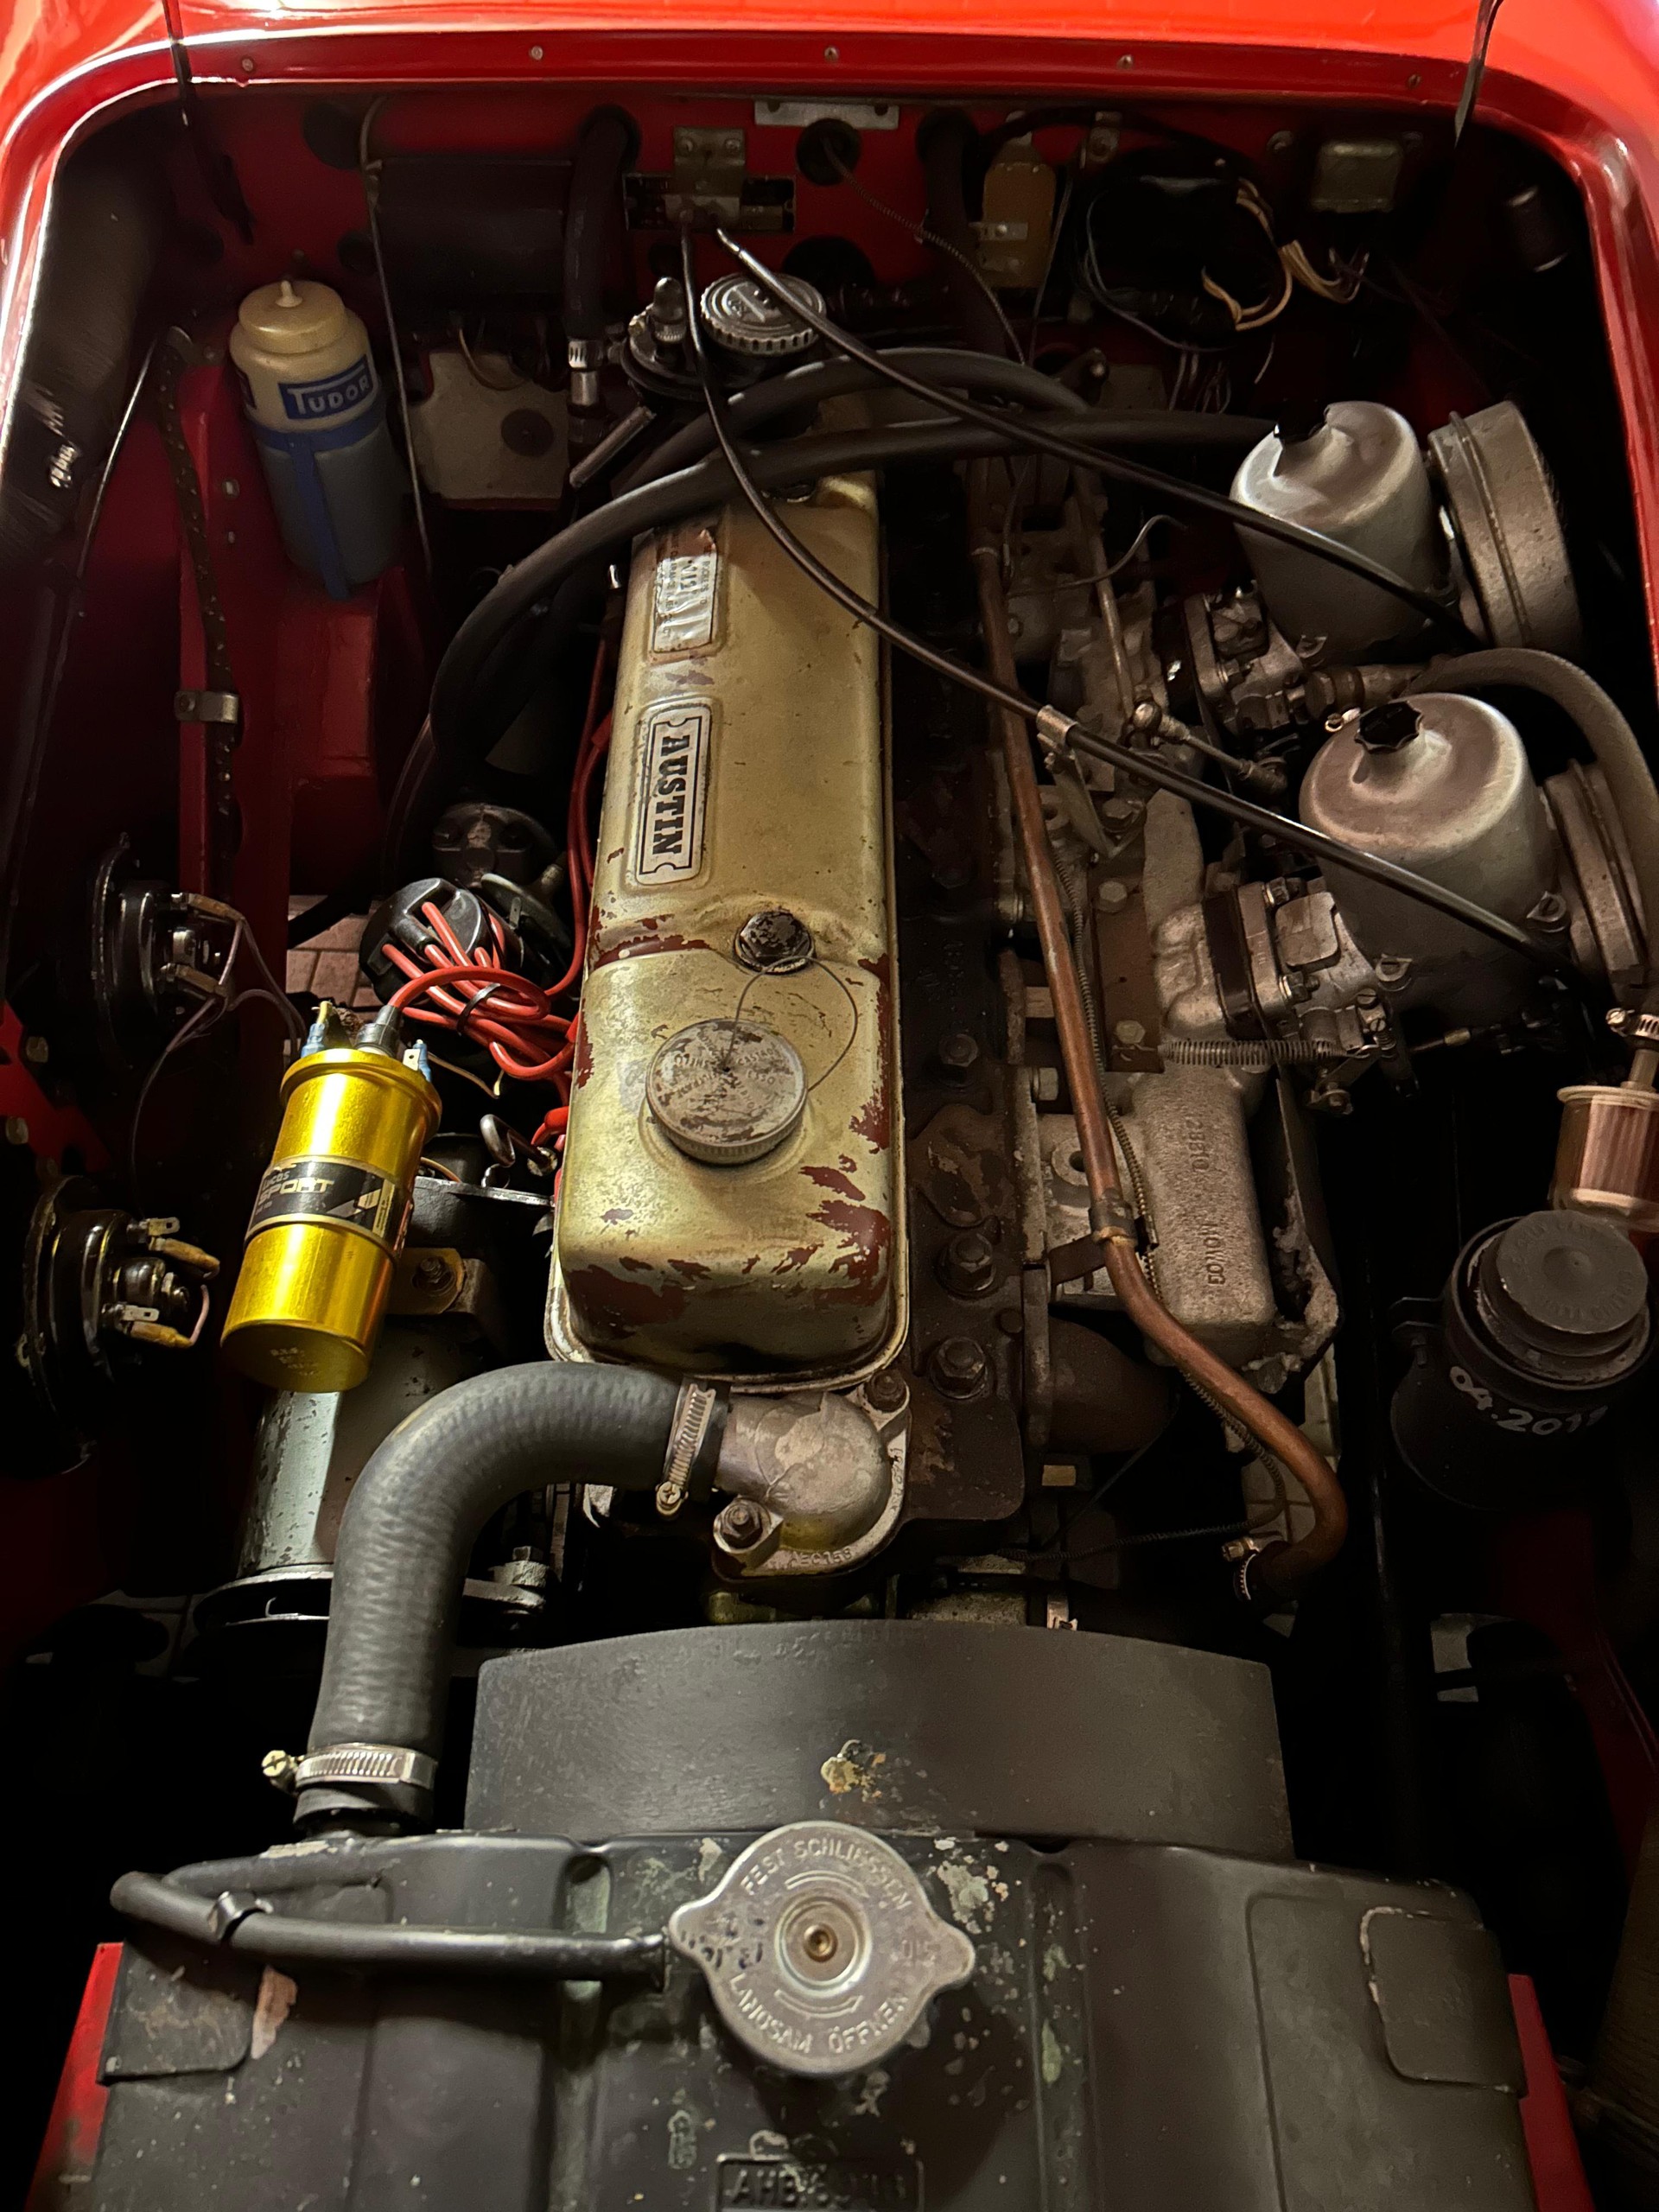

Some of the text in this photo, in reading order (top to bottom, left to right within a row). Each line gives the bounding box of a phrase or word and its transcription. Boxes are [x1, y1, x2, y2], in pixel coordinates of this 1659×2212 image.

[287, 362, 371, 416] TUDOR
[652, 734, 690, 855] AUSTIN
[258, 1177, 335, 1206] SPORT
[740, 1838, 912, 1910] FEST SCHLIESSEN
[729, 1972, 909, 2054] LANGSAM ÖFFNEN
